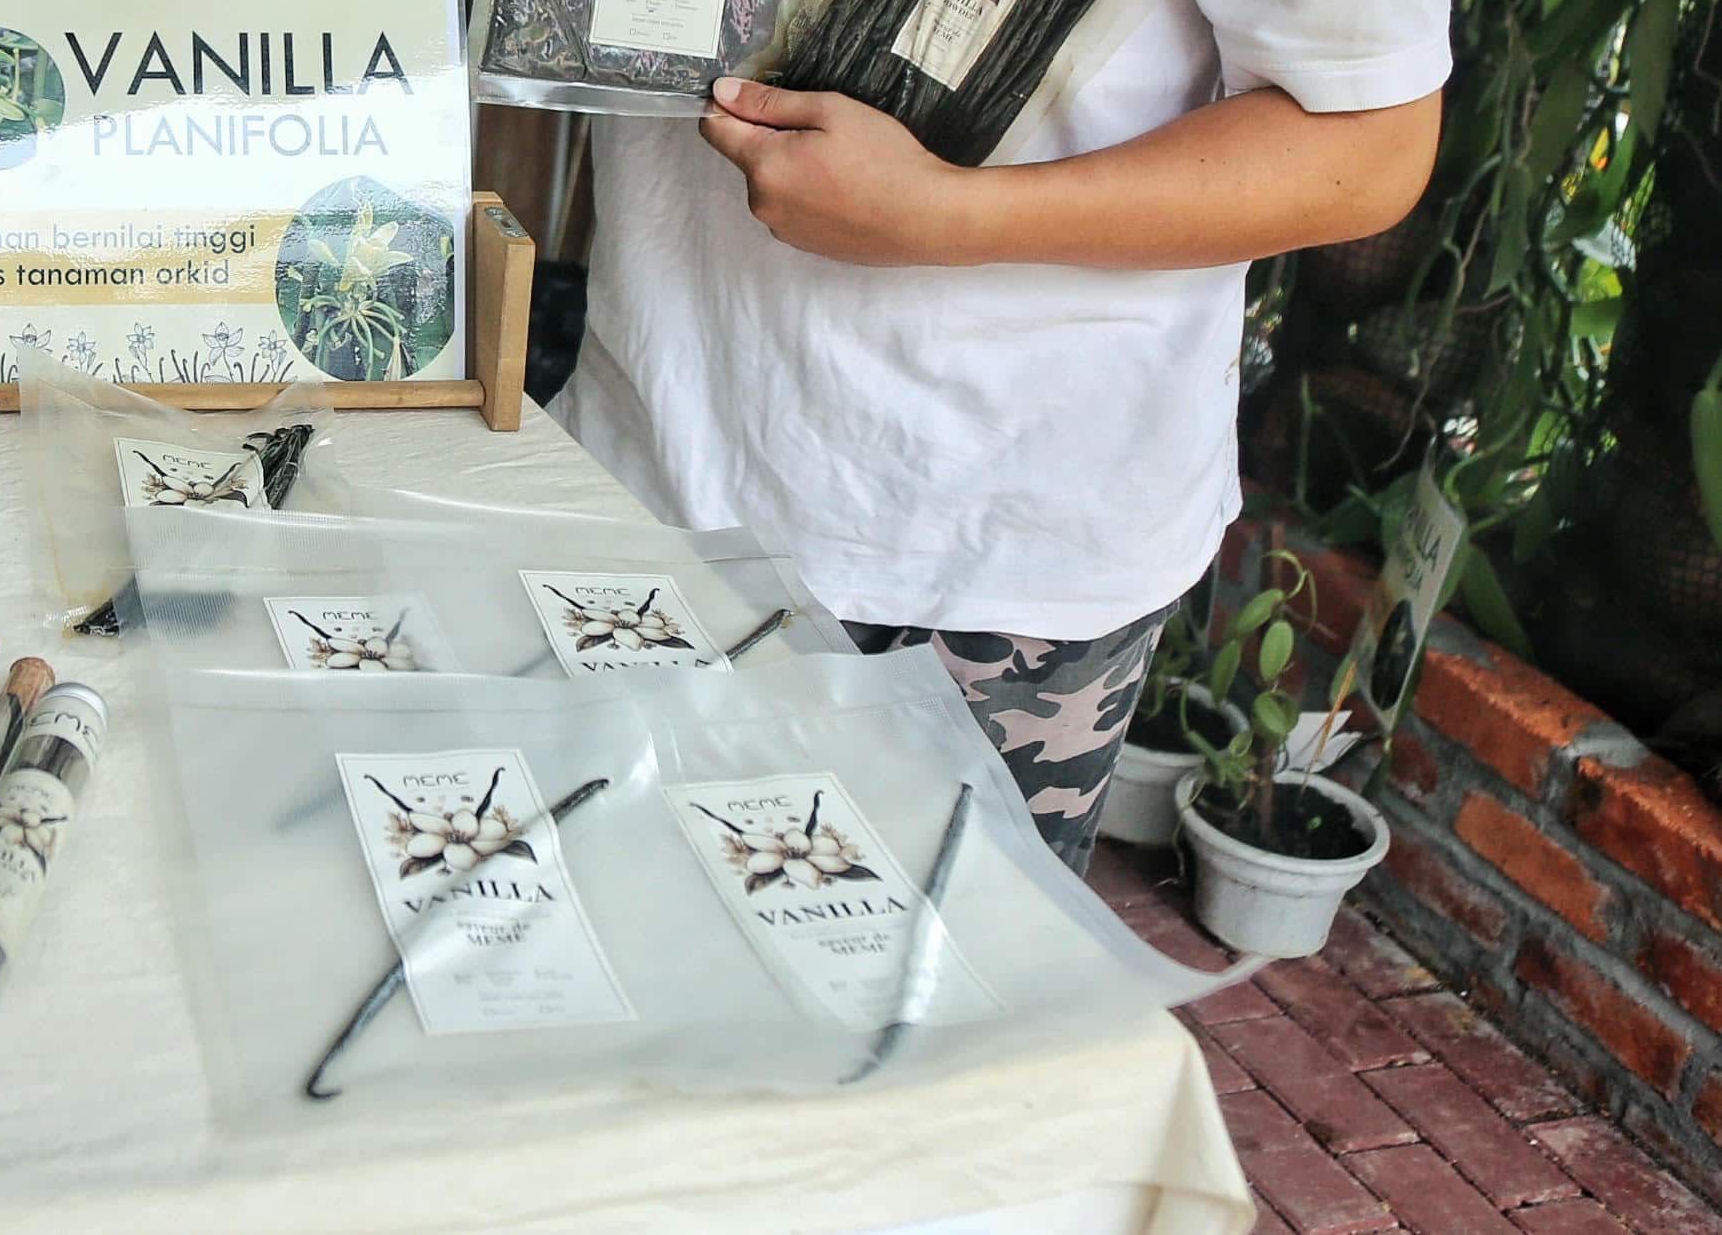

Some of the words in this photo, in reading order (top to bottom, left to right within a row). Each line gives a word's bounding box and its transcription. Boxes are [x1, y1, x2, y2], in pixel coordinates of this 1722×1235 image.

[64, 30, 415, 96] VANILLA
[93, 114, 389, 157] PLANIFOLIA
[53, 224, 163, 249] bernilai
[174, 223, 256, 256] tinggi
[16, 264, 144, 286] tanaman
[156, 260, 230, 286] orkid
[403, 880, 557, 914] VANILLA
[758, 896, 909, 925] VANILLA
